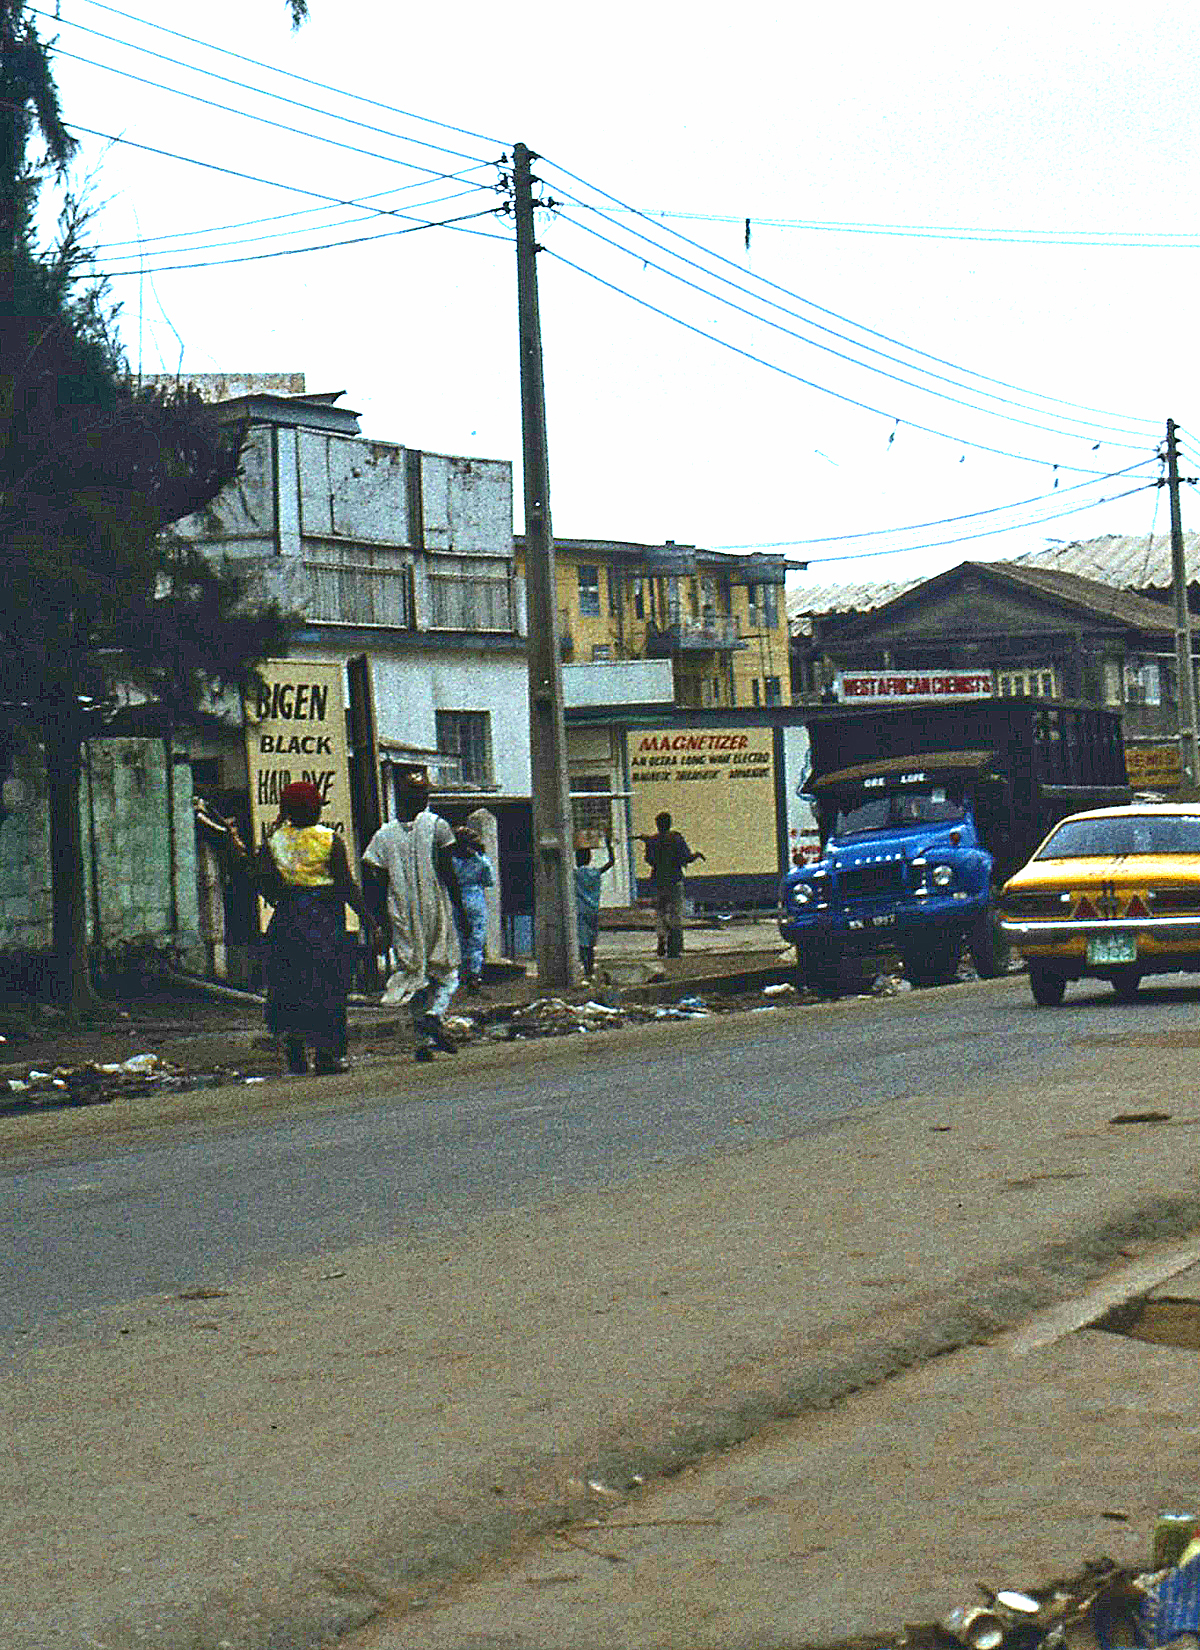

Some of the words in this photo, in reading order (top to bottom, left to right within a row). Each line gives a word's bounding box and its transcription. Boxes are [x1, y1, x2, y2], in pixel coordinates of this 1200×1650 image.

[256, 683, 328, 721] BIGEN
[260, 734, 332, 755] BLACK
[639, 735, 749, 751] MAGNETIZER
